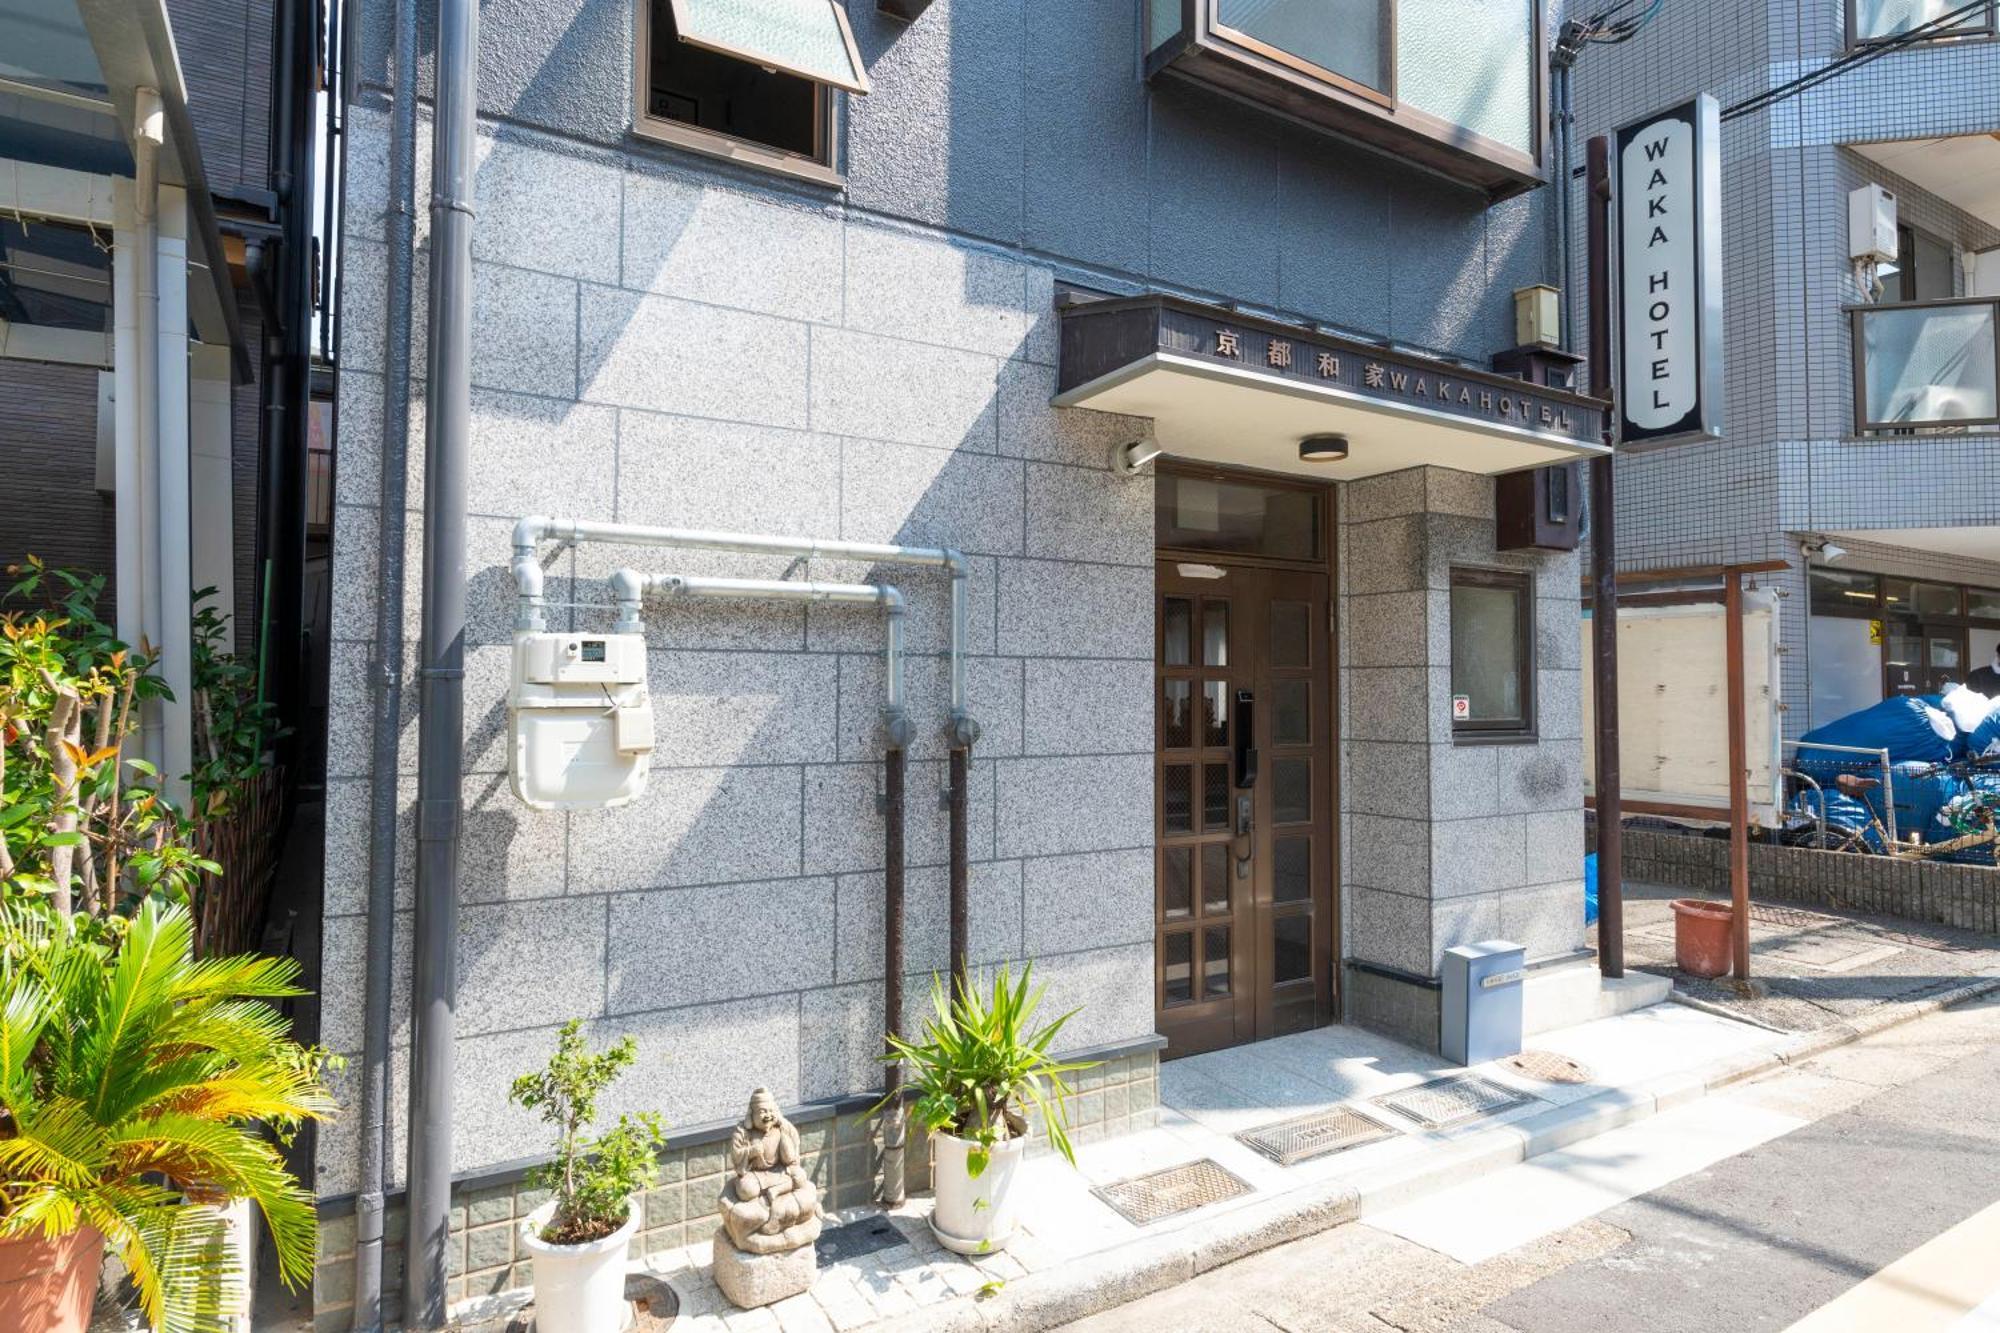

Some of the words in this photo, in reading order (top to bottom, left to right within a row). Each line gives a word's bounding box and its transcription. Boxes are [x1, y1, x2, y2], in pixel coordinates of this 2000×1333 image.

[1645, 137, 1669, 248] WAKA
[1216, 329, 1384, 388] 京都和家
[1649, 271, 1670, 410] HOTEL
